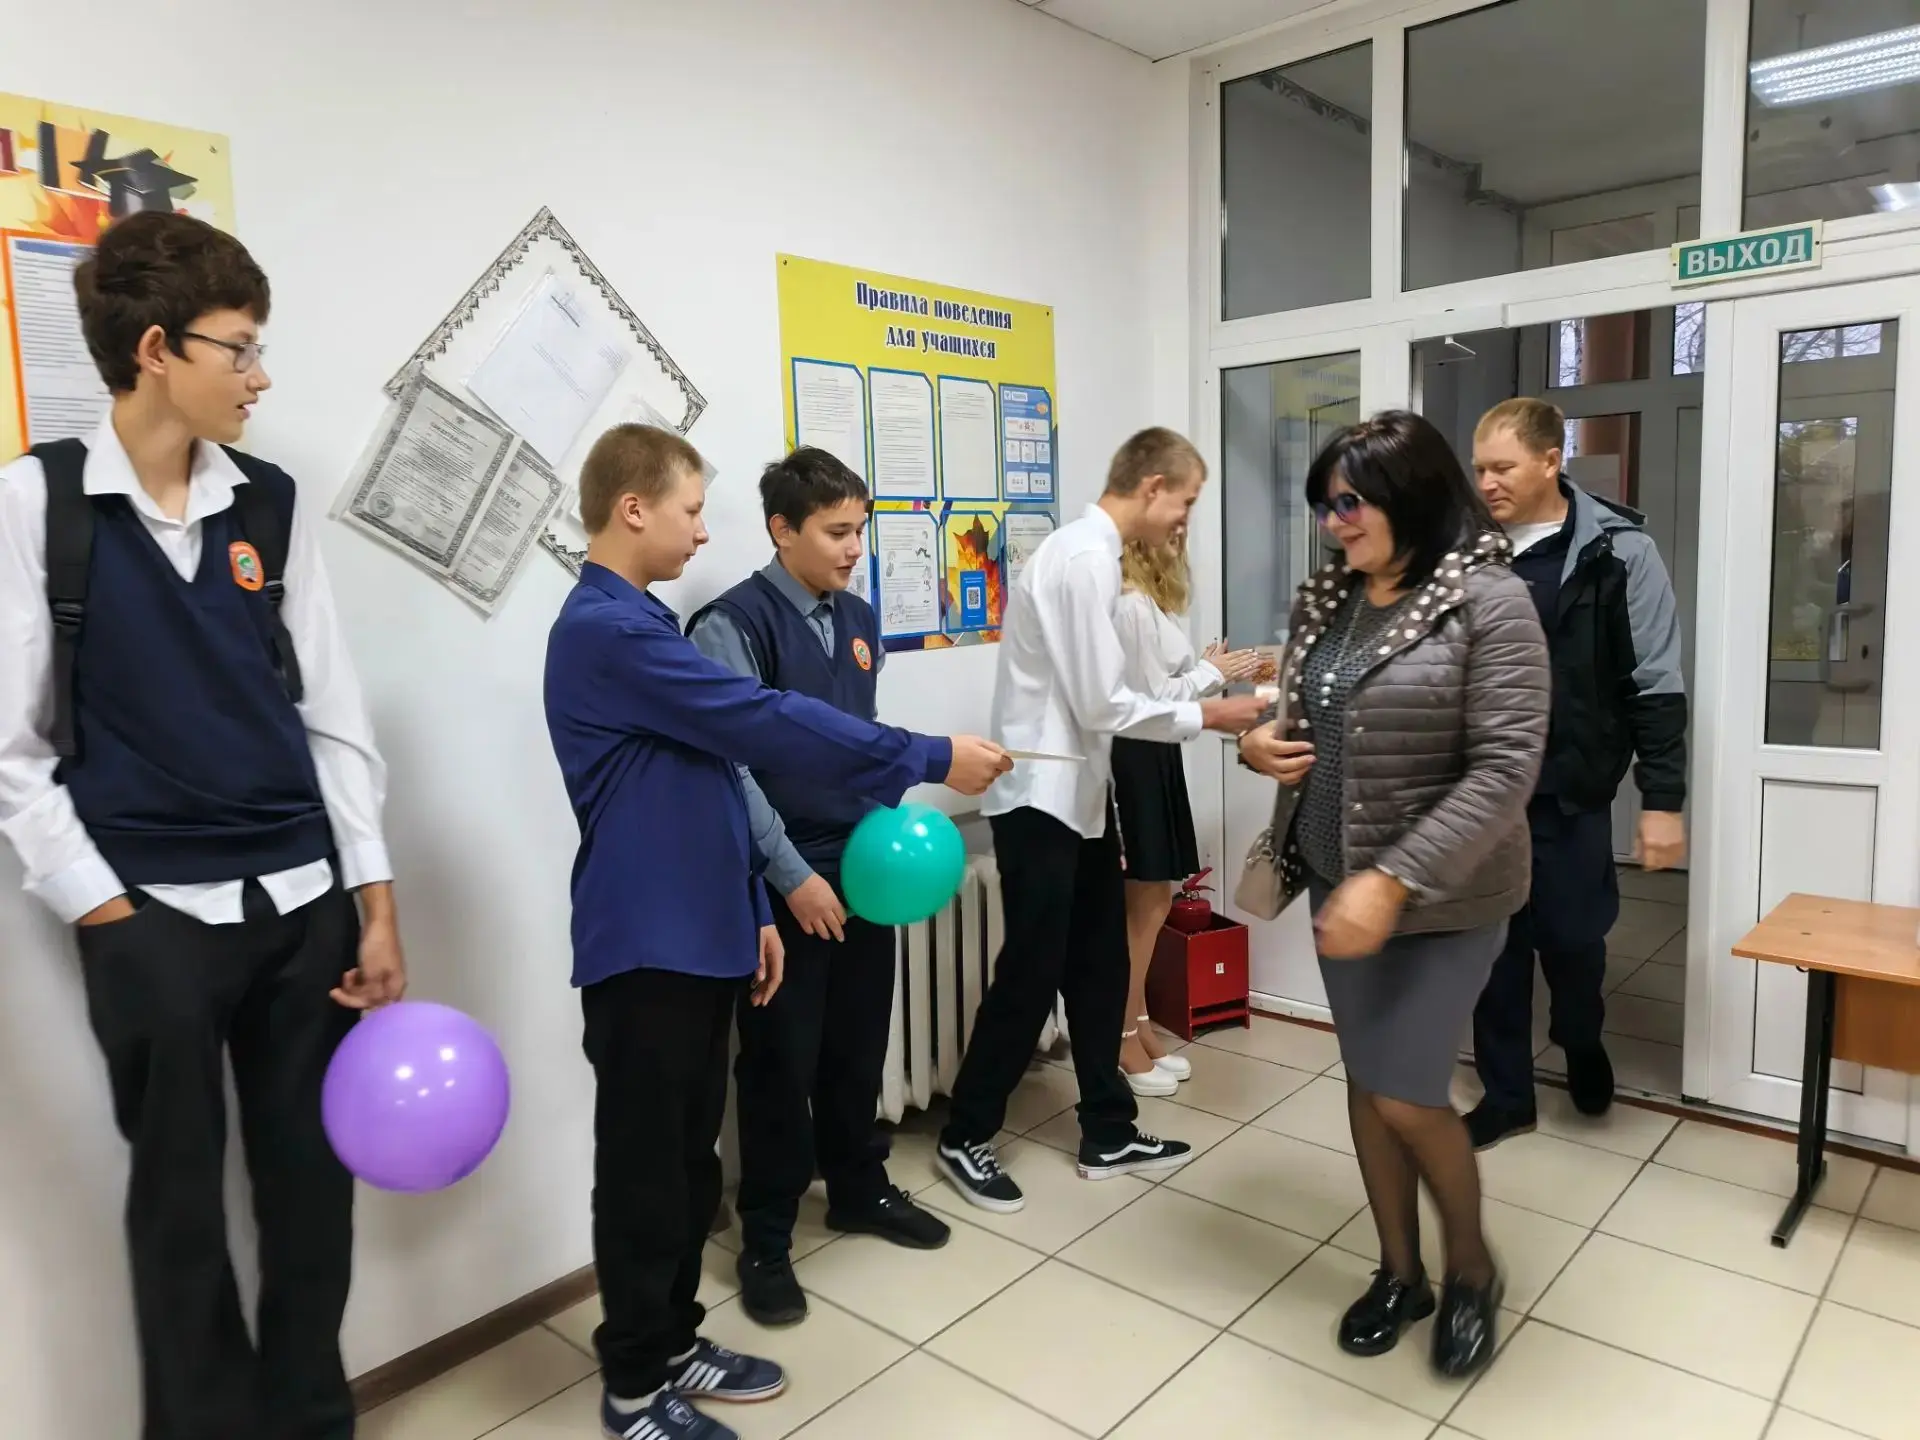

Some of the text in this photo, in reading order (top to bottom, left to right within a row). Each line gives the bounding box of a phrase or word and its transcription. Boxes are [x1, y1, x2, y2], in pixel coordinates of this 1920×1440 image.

[1687, 234, 1806, 275] ВЫХОД
[856, 282, 1012, 329] Правила поведения
[886, 326, 996, 359] для учащихся
